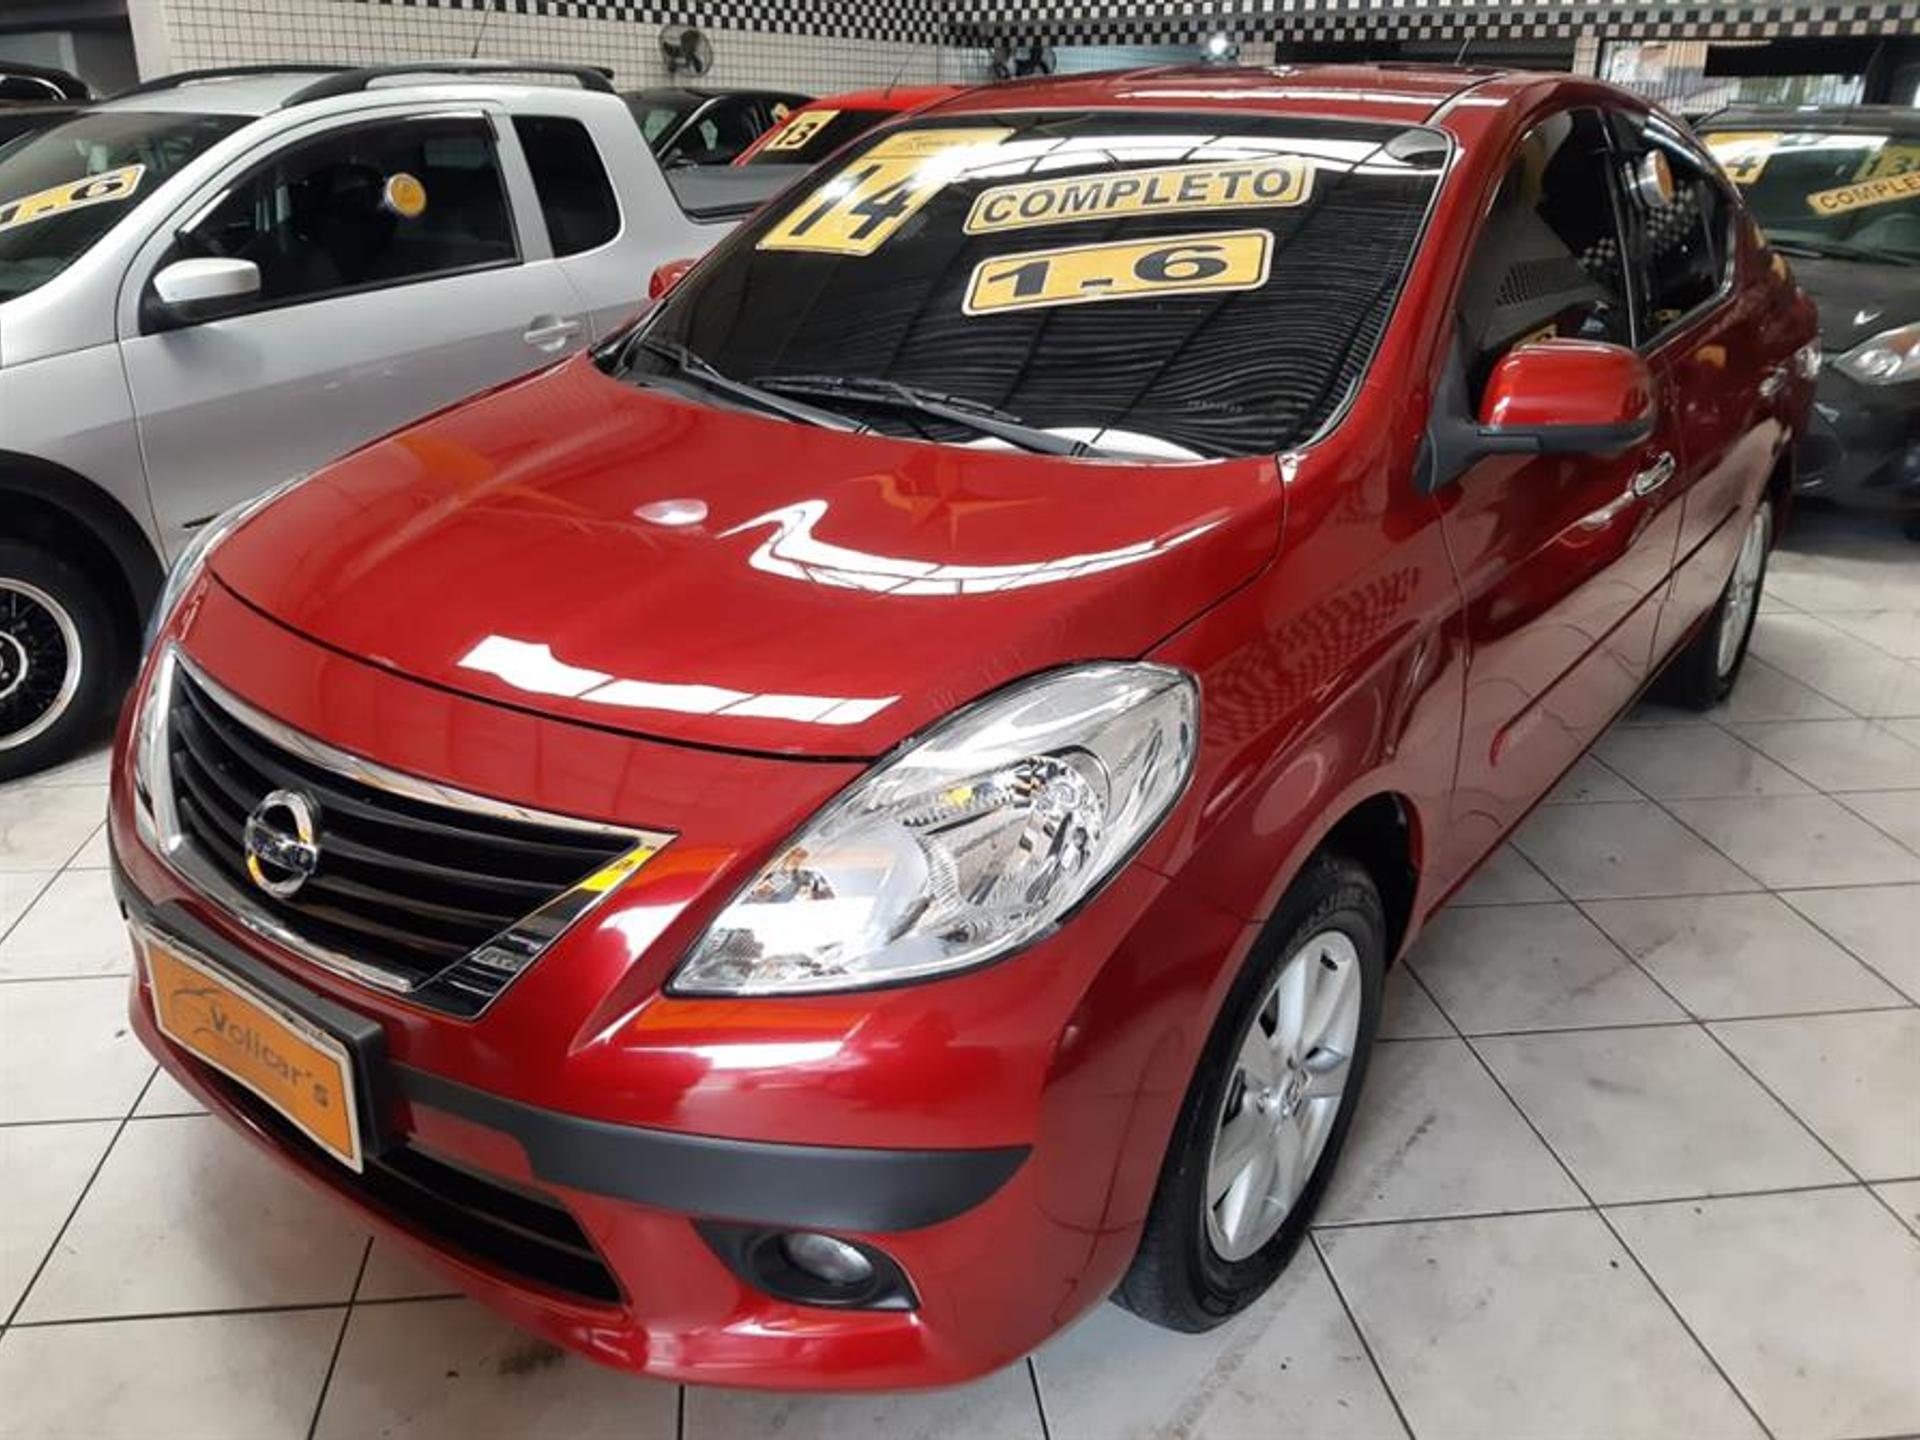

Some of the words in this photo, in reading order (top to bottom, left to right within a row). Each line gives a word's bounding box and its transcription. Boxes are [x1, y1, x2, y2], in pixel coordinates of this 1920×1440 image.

[776, 122, 820, 146] 13
[788, 163, 914, 241] 14
[982, 168, 1292, 224] COMPLETO
